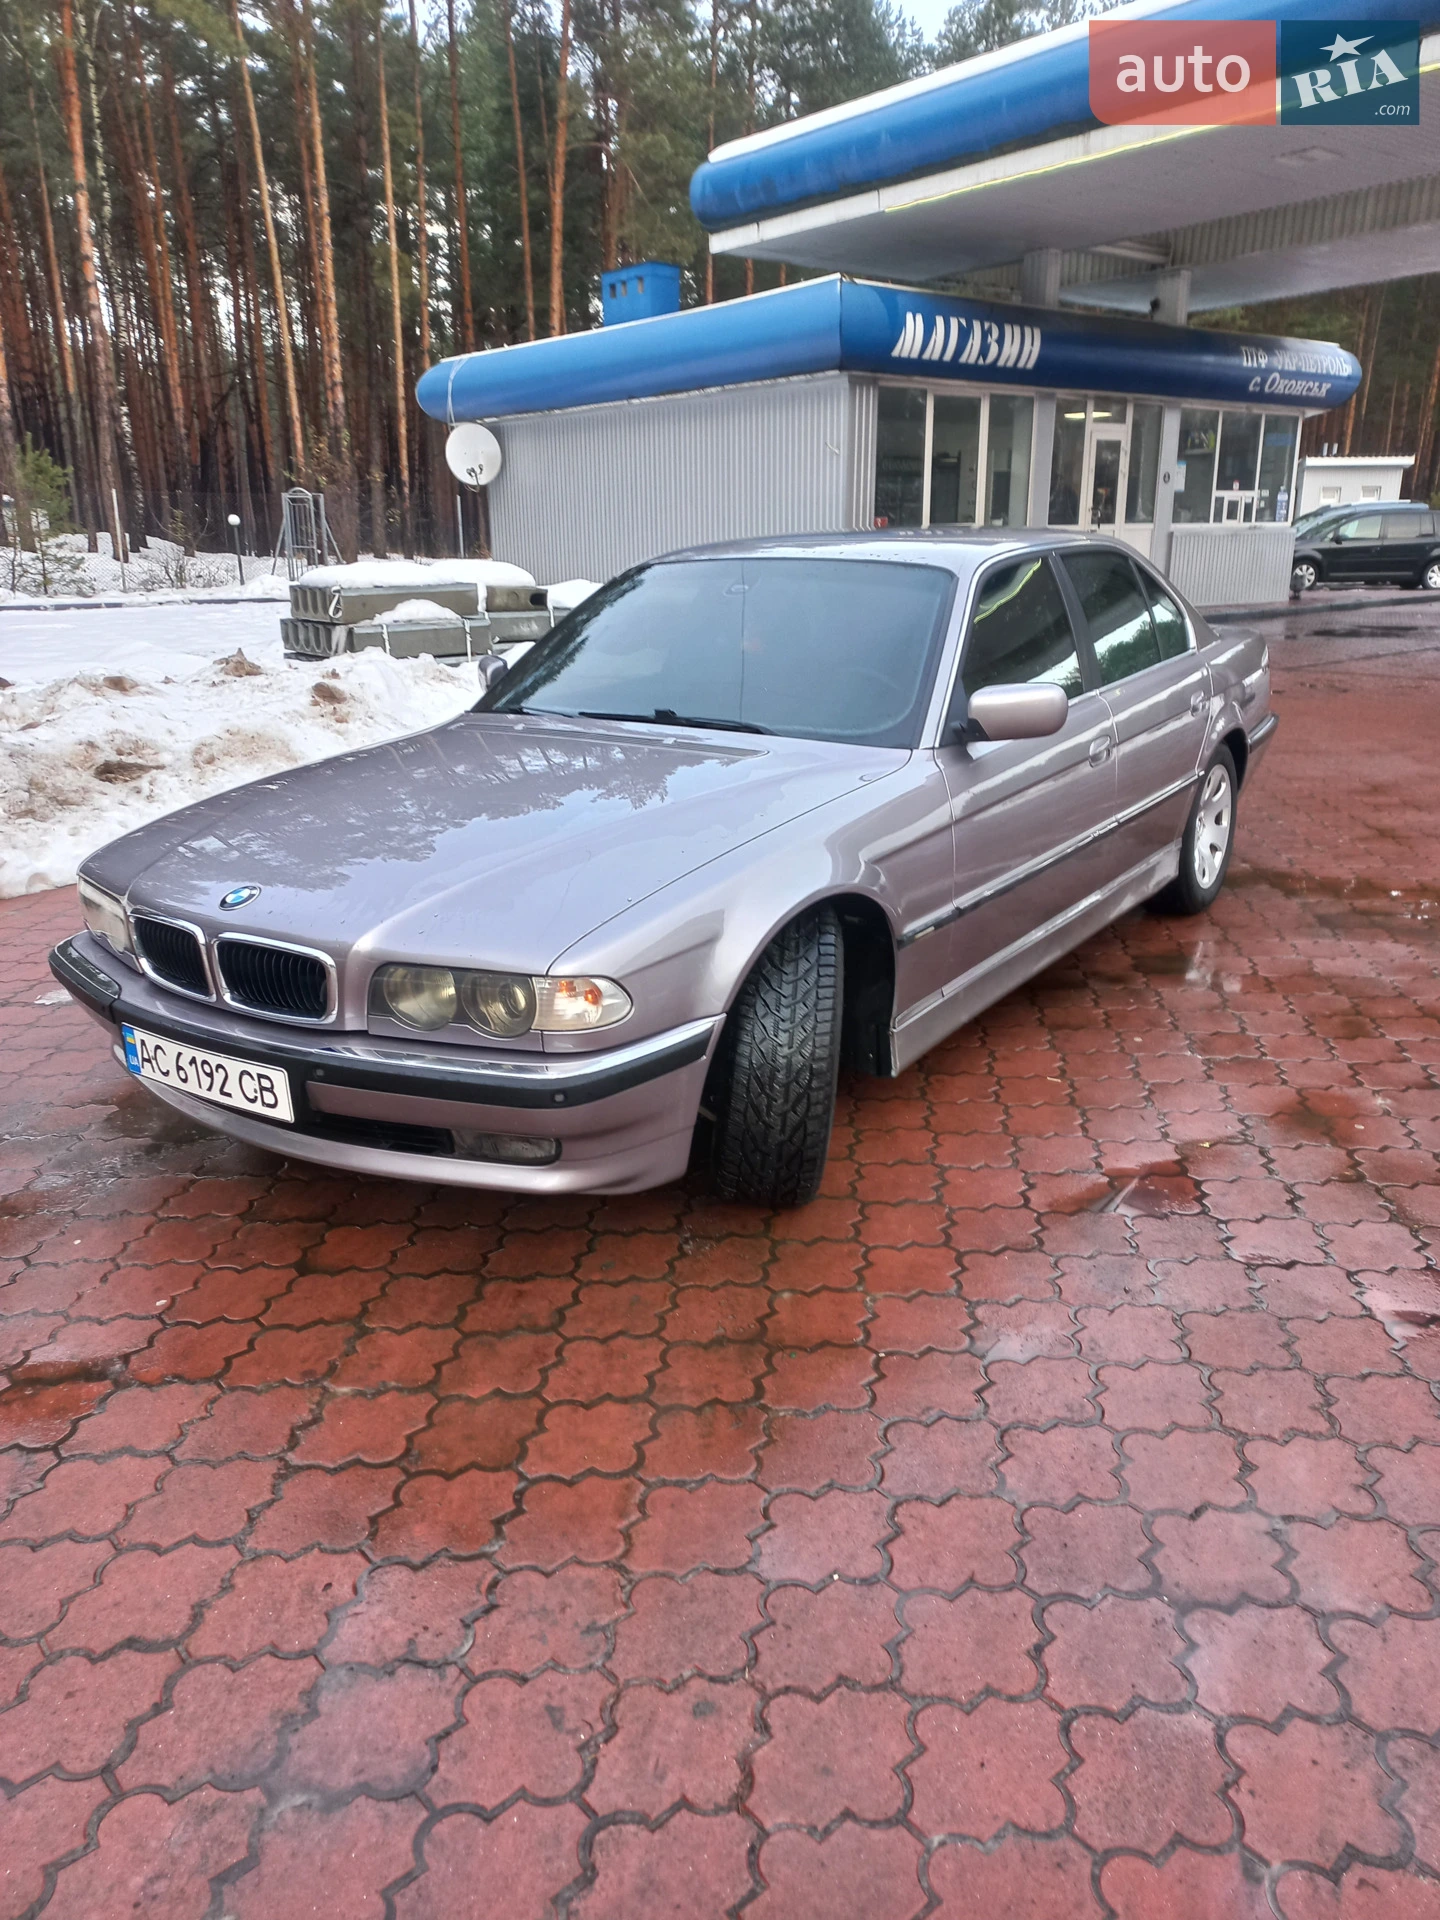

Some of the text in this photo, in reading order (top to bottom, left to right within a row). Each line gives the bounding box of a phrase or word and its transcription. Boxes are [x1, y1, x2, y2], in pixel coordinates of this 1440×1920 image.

[891, 311, 1041, 370] МАГАЗИН
[1241, 346, 1268, 368] ПТФ
[1265, 372, 1331, 397] Оконськ
[129, 1054, 139, 1067] UA
[140, 1039, 279, 1109] AC 6192 CB
